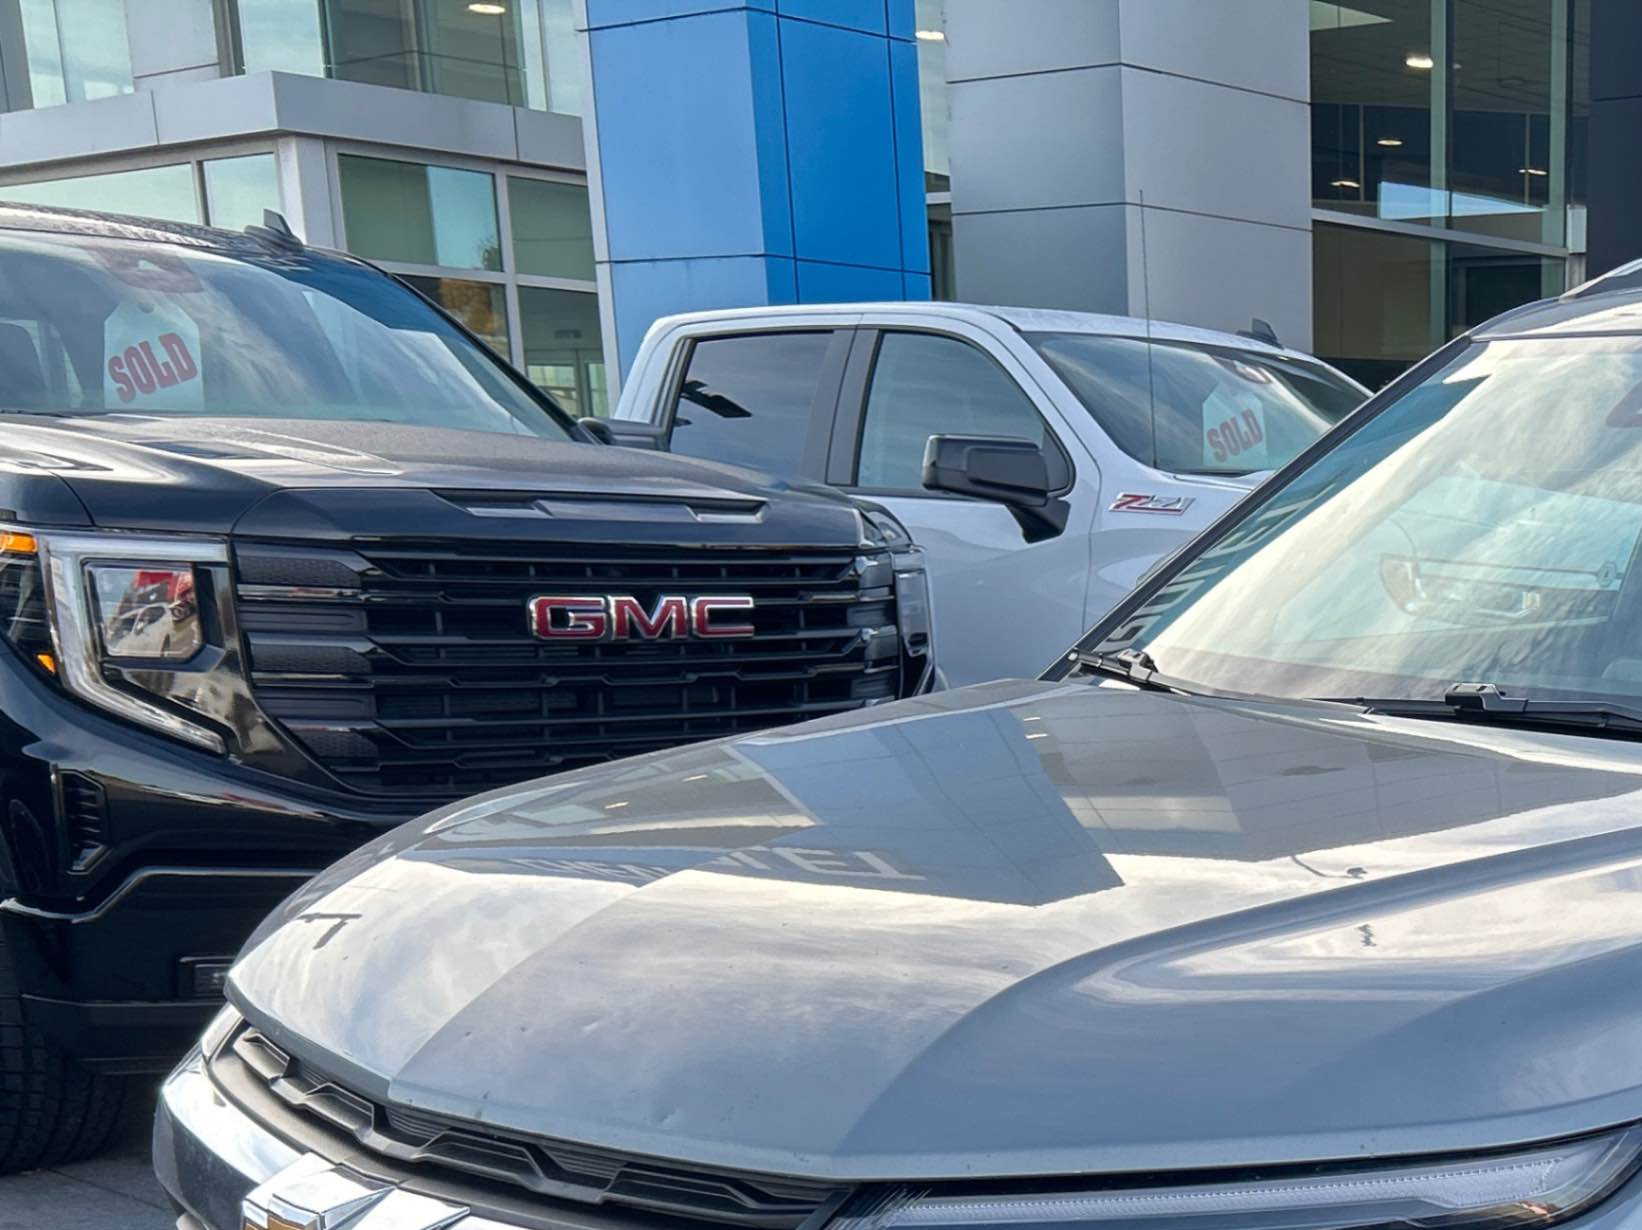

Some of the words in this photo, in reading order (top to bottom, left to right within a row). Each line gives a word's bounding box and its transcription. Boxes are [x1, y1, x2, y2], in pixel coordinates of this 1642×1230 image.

[107, 332, 199, 403] SOLD
[1207, 407, 1263, 463] SOLD
[528, 595, 756, 641] GMC
